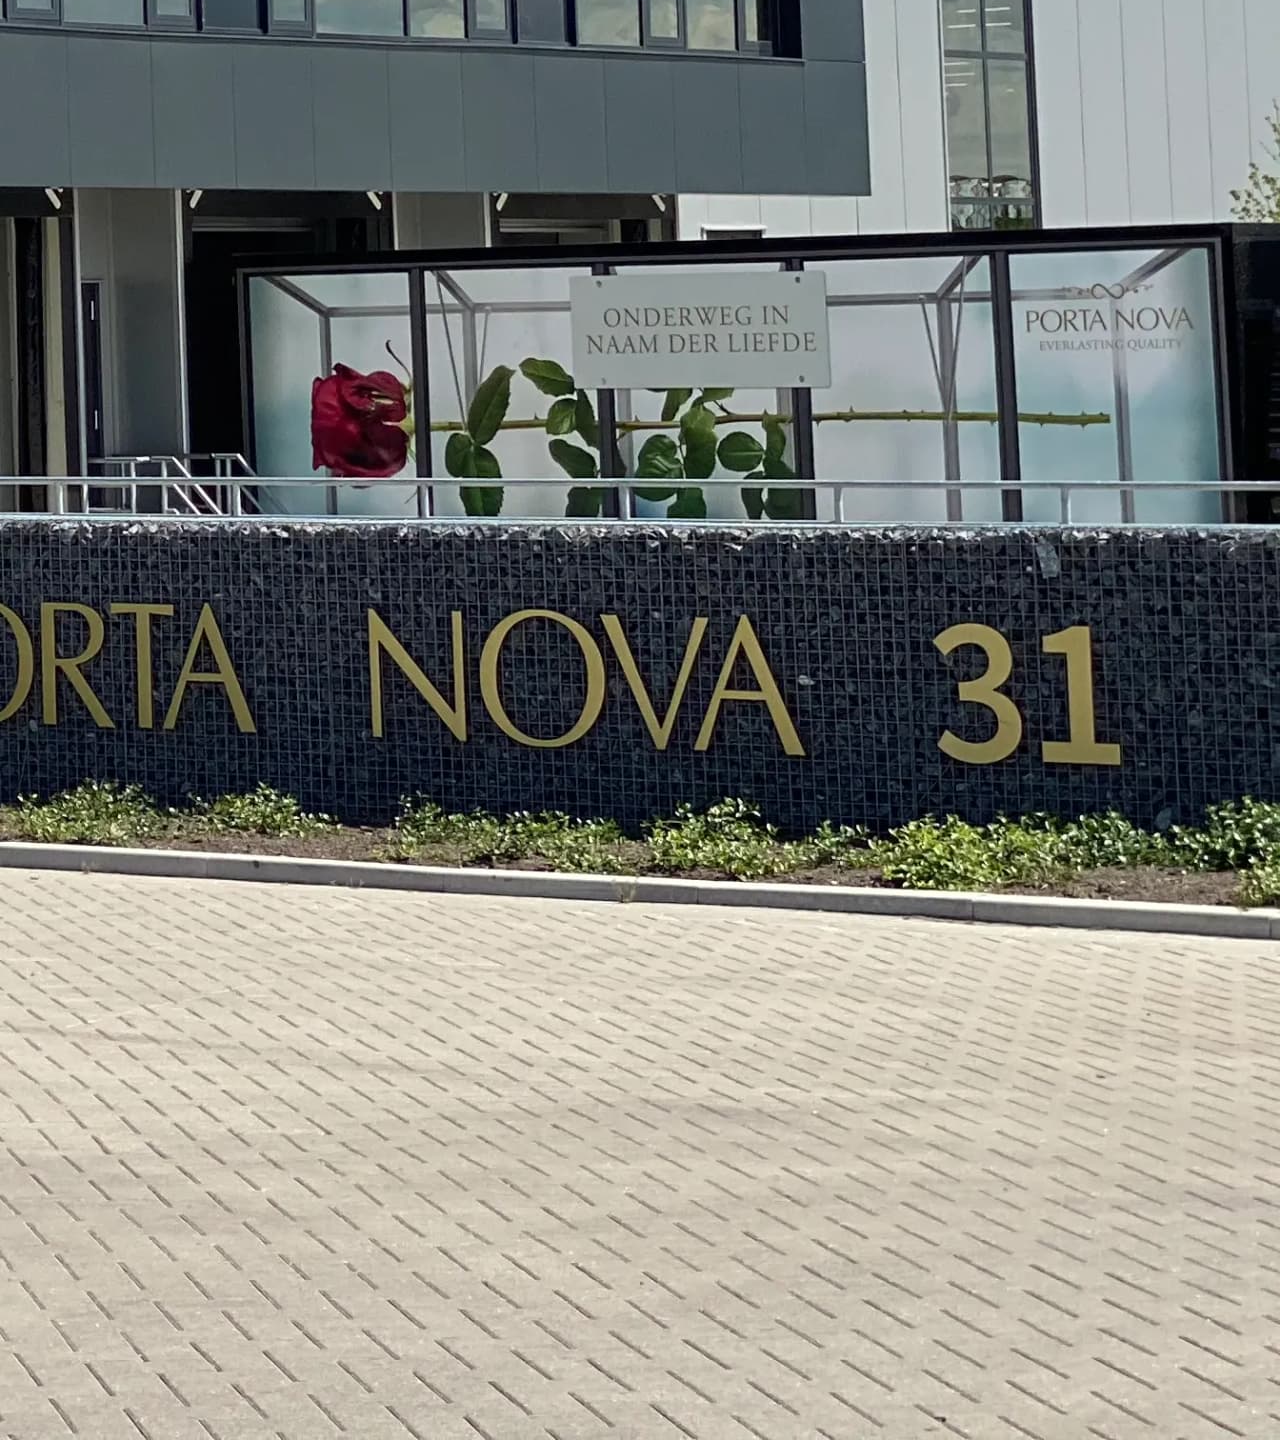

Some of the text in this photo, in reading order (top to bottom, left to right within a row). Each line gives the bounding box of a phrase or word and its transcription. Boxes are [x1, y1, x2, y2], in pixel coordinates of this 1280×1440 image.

[603, 305, 790, 328] ONDERWEG IN
[1025, 307, 1194, 333] PORTA NOVA
[586, 332, 817, 354] NAAM DER LIEFDE
[1039, 338, 1183, 353] EVERLASTING QUALITY
[369, 610, 806, 756] NOVA
[933, 624, 1121, 766] 31
